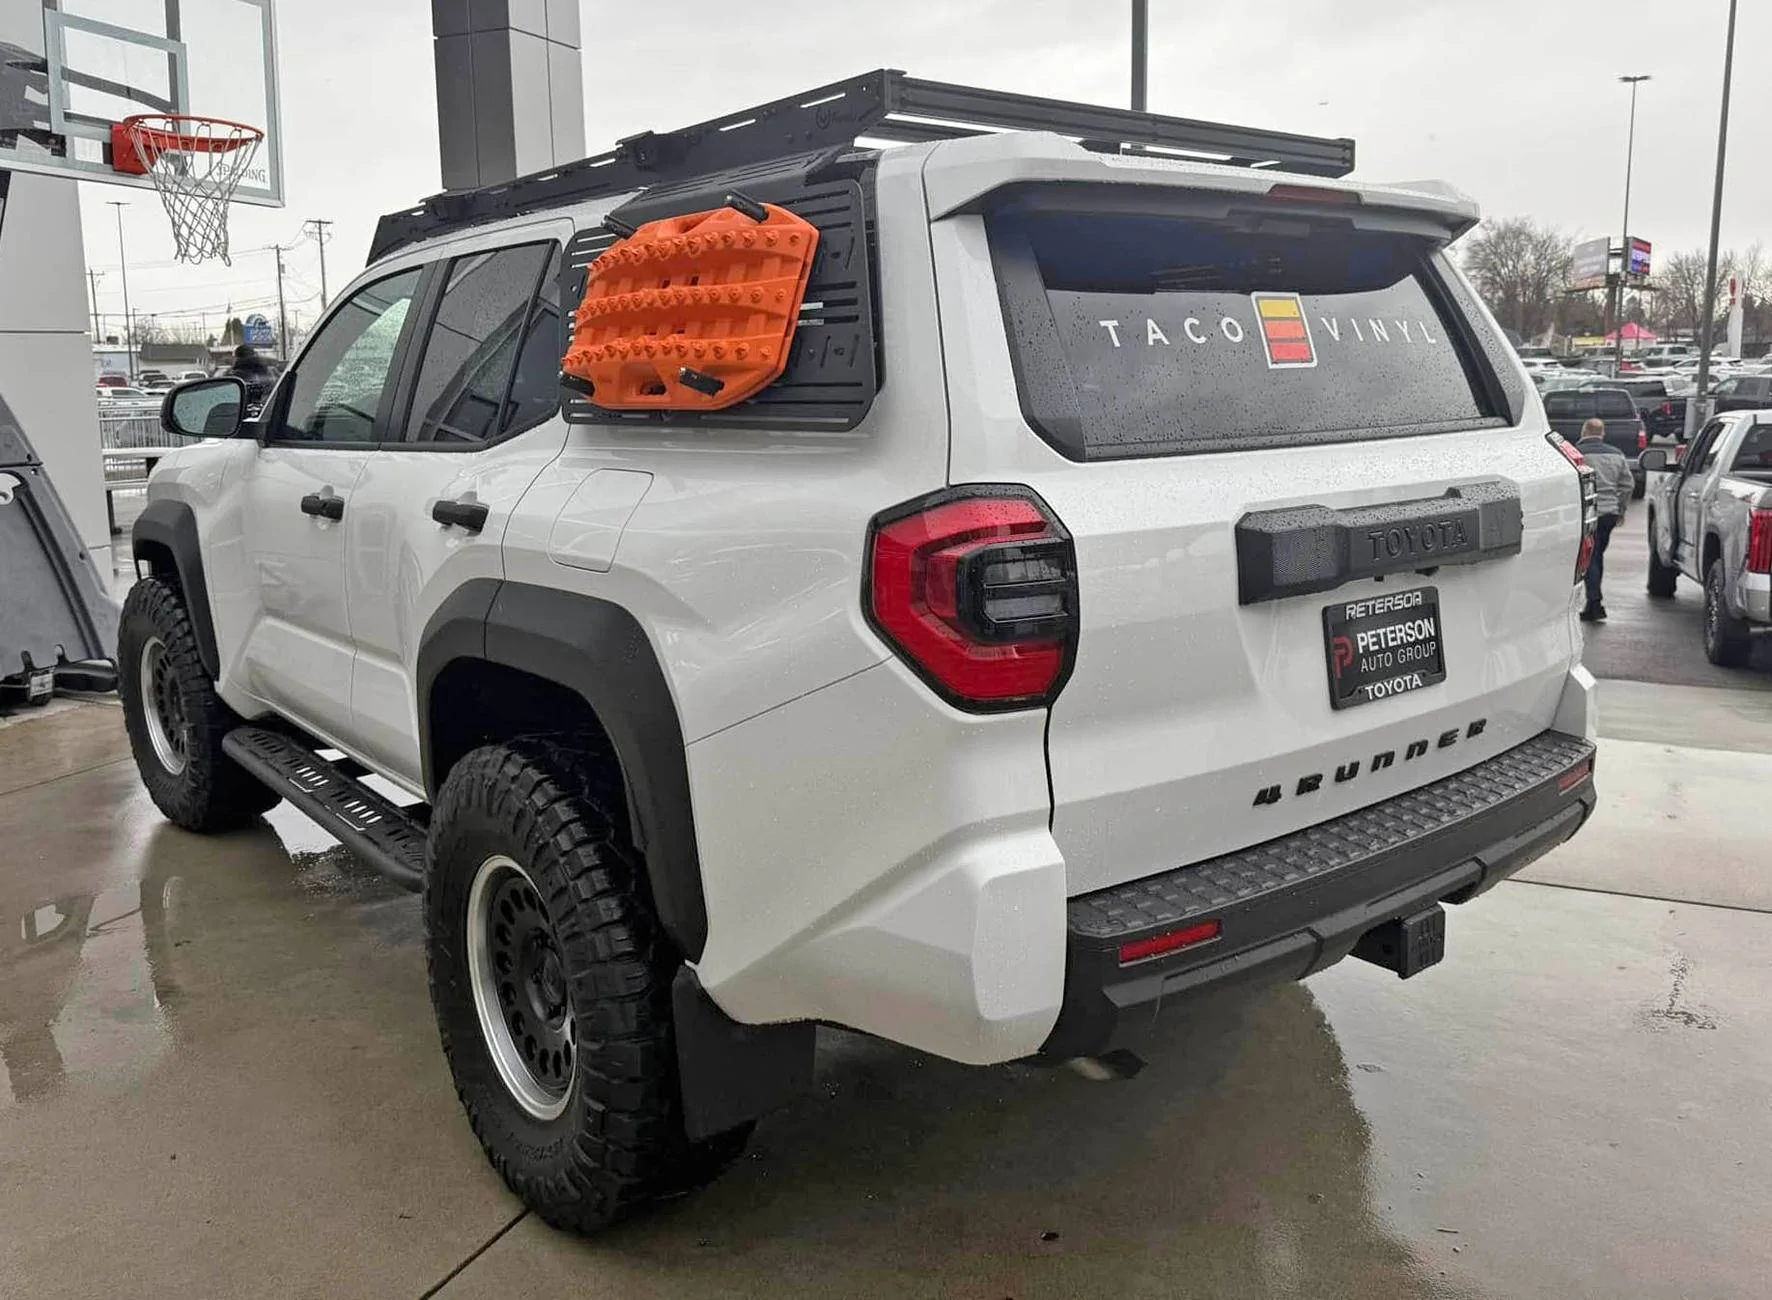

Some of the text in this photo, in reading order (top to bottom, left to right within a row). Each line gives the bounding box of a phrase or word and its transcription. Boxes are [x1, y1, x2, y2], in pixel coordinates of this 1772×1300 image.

[215, 163, 267, 184] PDING
[1099, 316, 1437, 348] TACO VINYL
[1367, 518, 1468, 561] TOYOTA
[1356, 617, 1436, 654] PETERSON
[1360, 641, 1437, 673] AUTO GROUP
[1365, 673, 1423, 700] TOYOTA
[1252, 717, 1488, 807] 4RUNNER
